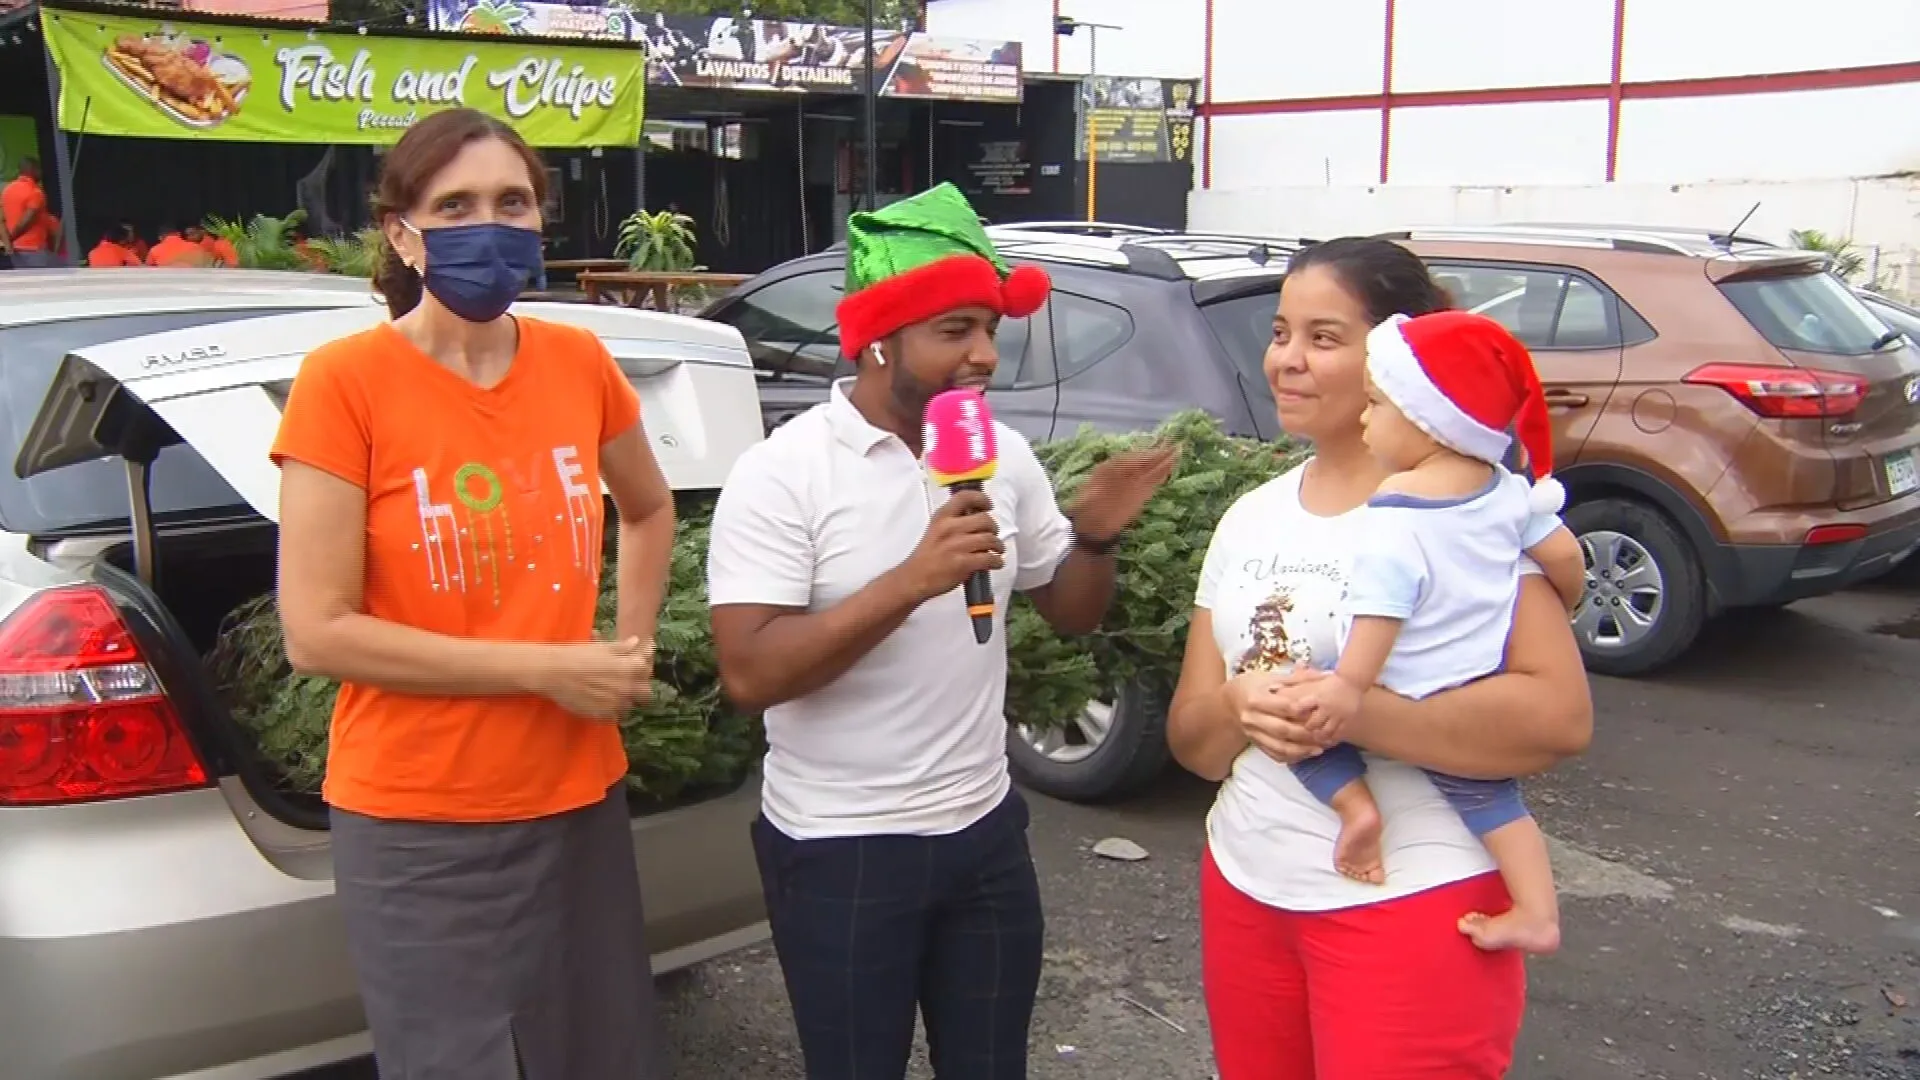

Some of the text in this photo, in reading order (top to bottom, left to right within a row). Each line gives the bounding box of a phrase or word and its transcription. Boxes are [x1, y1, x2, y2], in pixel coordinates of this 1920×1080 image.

[274, 45, 616, 119] Fish and Chips
[696, 60, 770, 79] LAVAUTOS
[781, 66, 853, 84] DETAILING
[412, 445, 590, 518] LOVE
